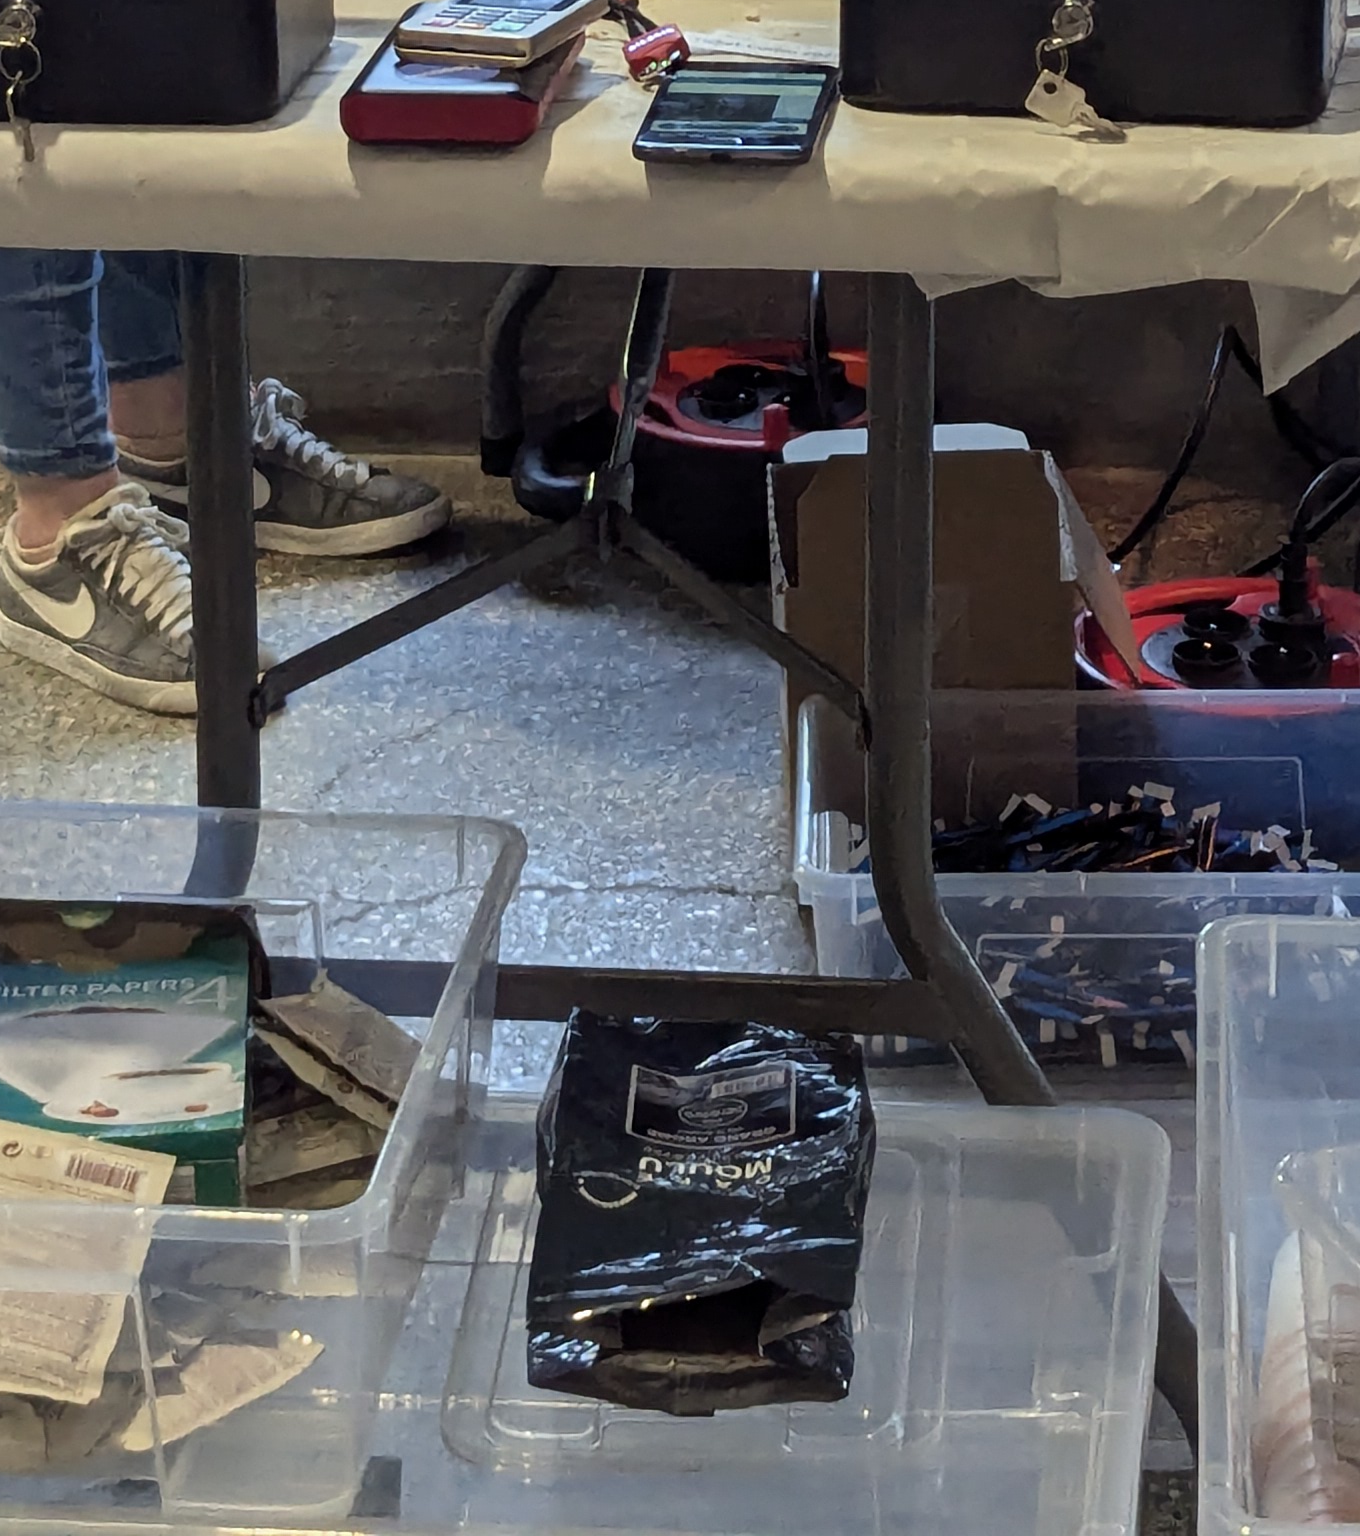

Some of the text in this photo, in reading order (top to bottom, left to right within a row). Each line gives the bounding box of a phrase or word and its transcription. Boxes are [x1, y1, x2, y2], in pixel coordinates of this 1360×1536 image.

[86, 976, 195, 996] PAPERS
[177, 975, 239, 1012] 4
[638, 1155, 774, 1181] MOULU
